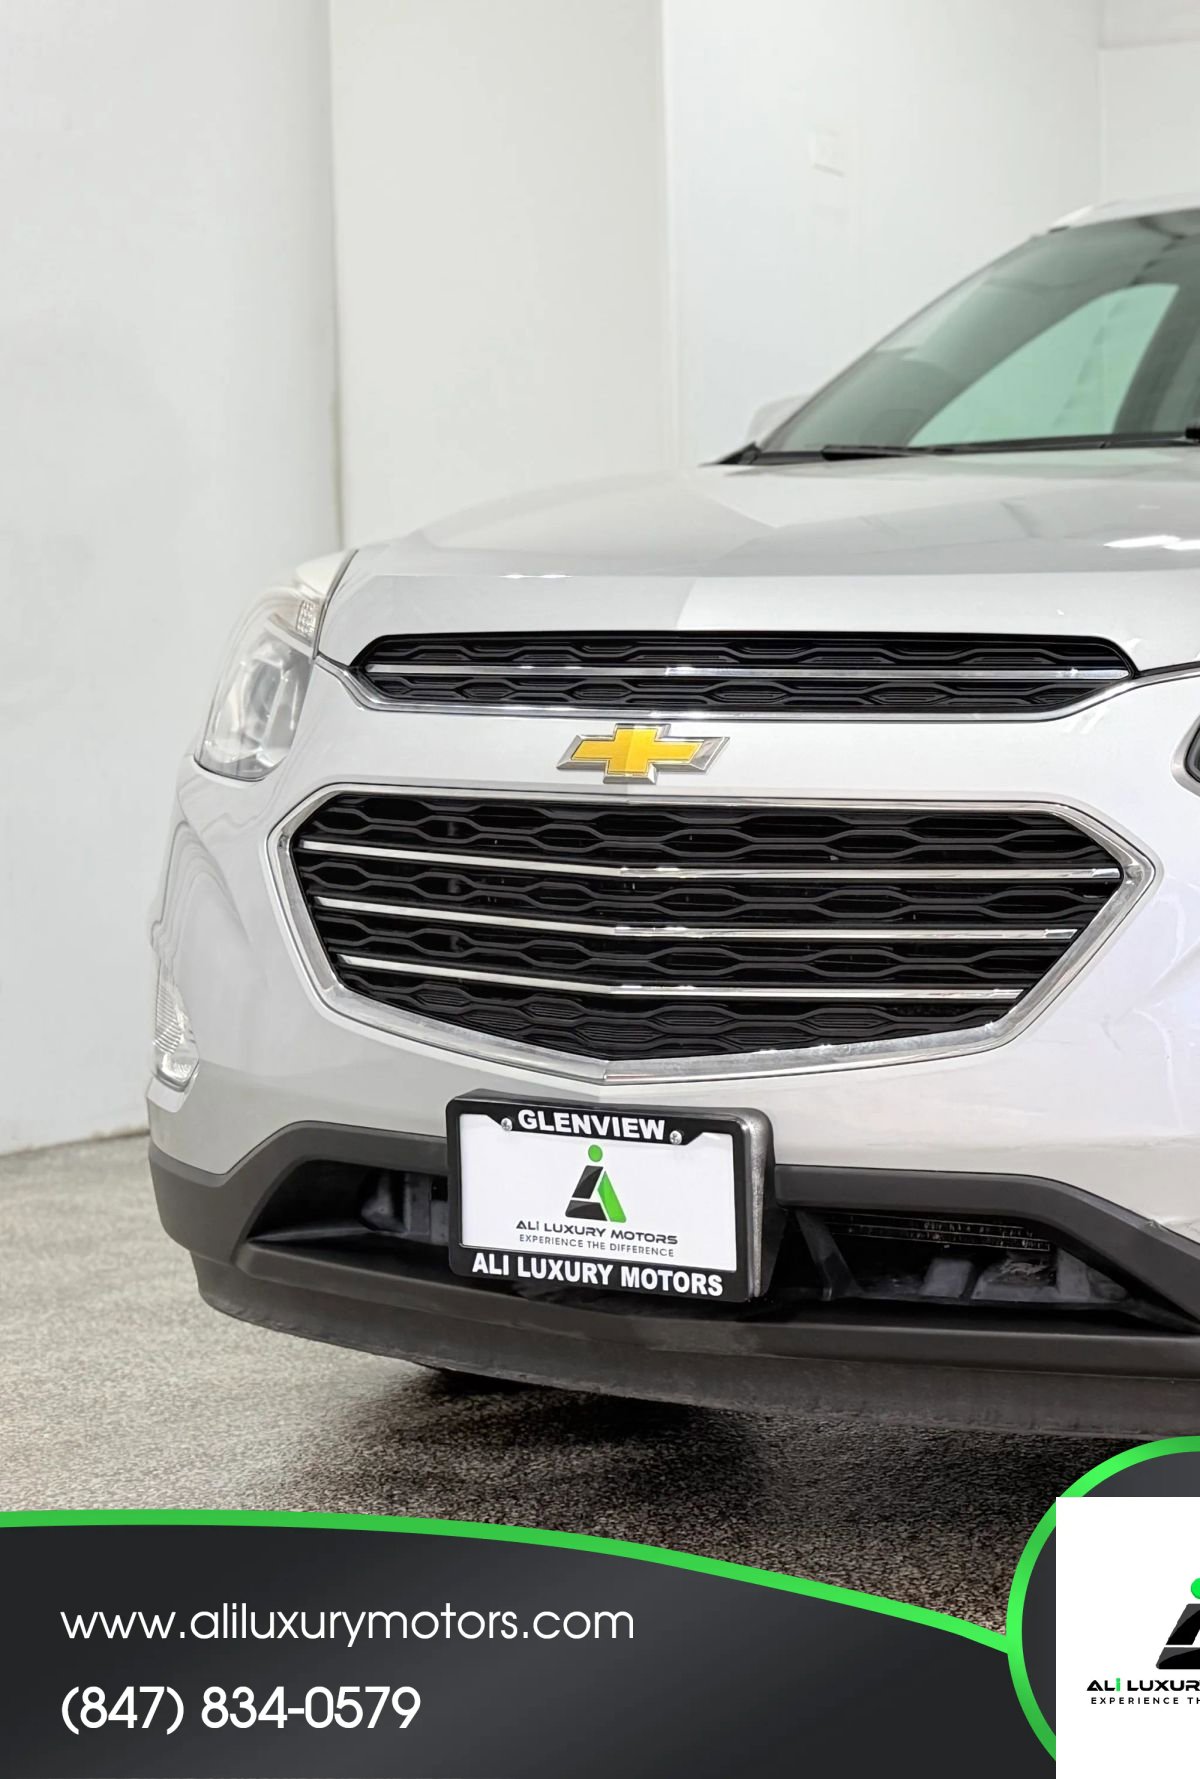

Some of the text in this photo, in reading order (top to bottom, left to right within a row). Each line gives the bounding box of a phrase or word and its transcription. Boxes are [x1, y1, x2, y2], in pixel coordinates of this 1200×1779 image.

[517, 1109, 666, 1141] GLENVIEW
[519, 1233, 675, 1257] EXPERIENCE THE DIFFERENCE
[544, 1222, 606, 1238] LUXURY
[610, 1229, 679, 1245] MOTORS
[471, 1252, 724, 1297] ALI LUXURY MOTORS
